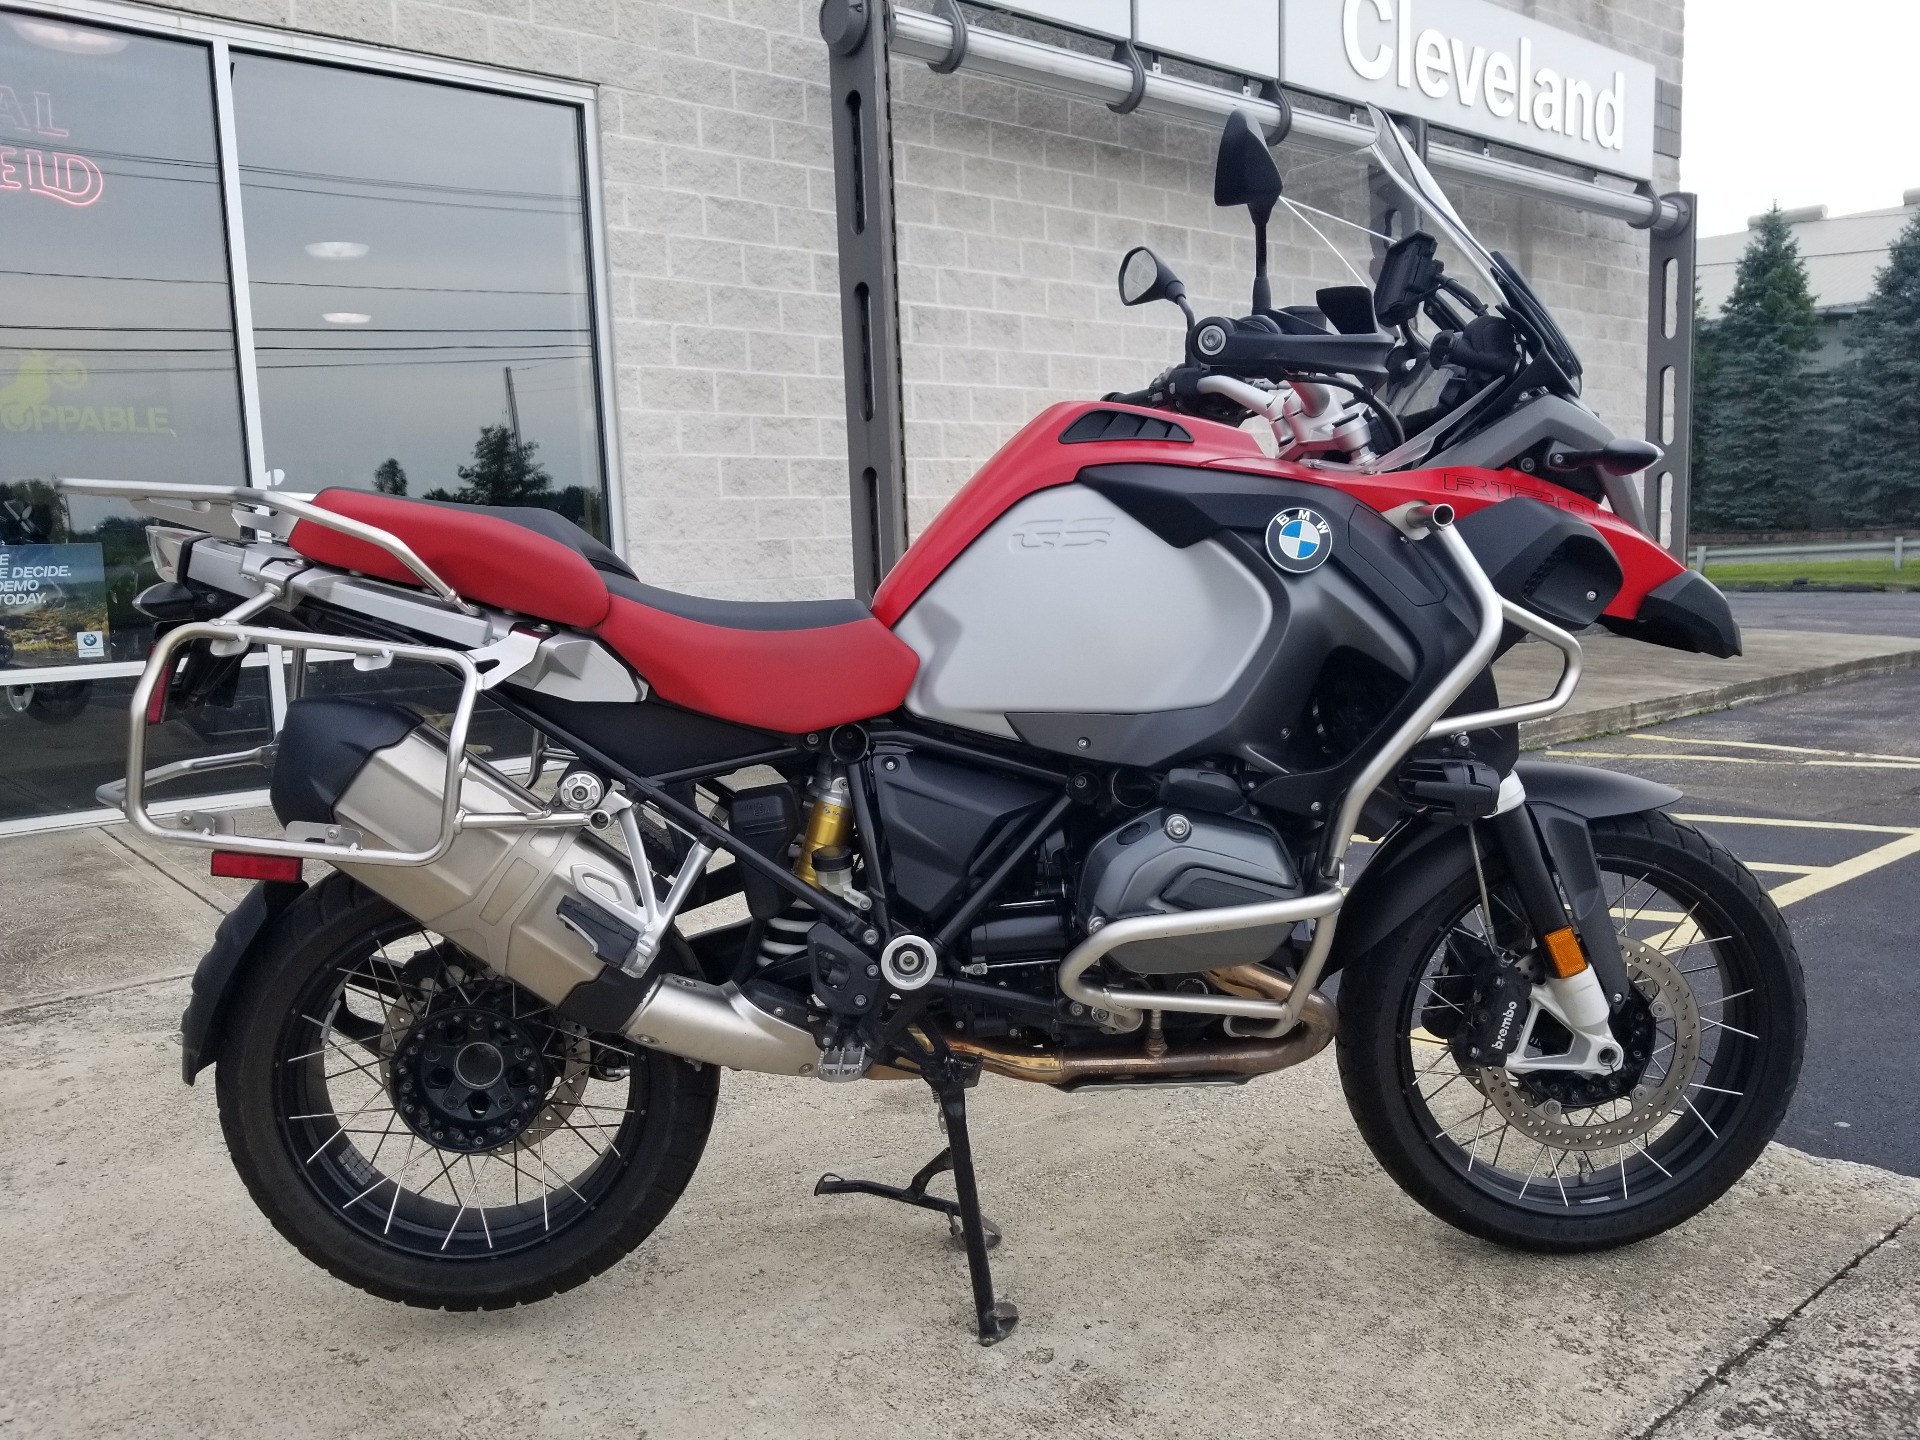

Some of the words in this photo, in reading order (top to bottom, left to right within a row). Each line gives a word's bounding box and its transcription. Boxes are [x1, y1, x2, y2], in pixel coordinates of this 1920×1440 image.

[1342, 0, 1625, 151] Cleveland
[1008, 517, 1116, 553] GS
[1276, 508, 1330, 535] BMW
[12, 565, 72, 579] DECIDE.
[0, 592, 47, 606] TODAY.
[1491, 1001, 1518, 1050] brembo
